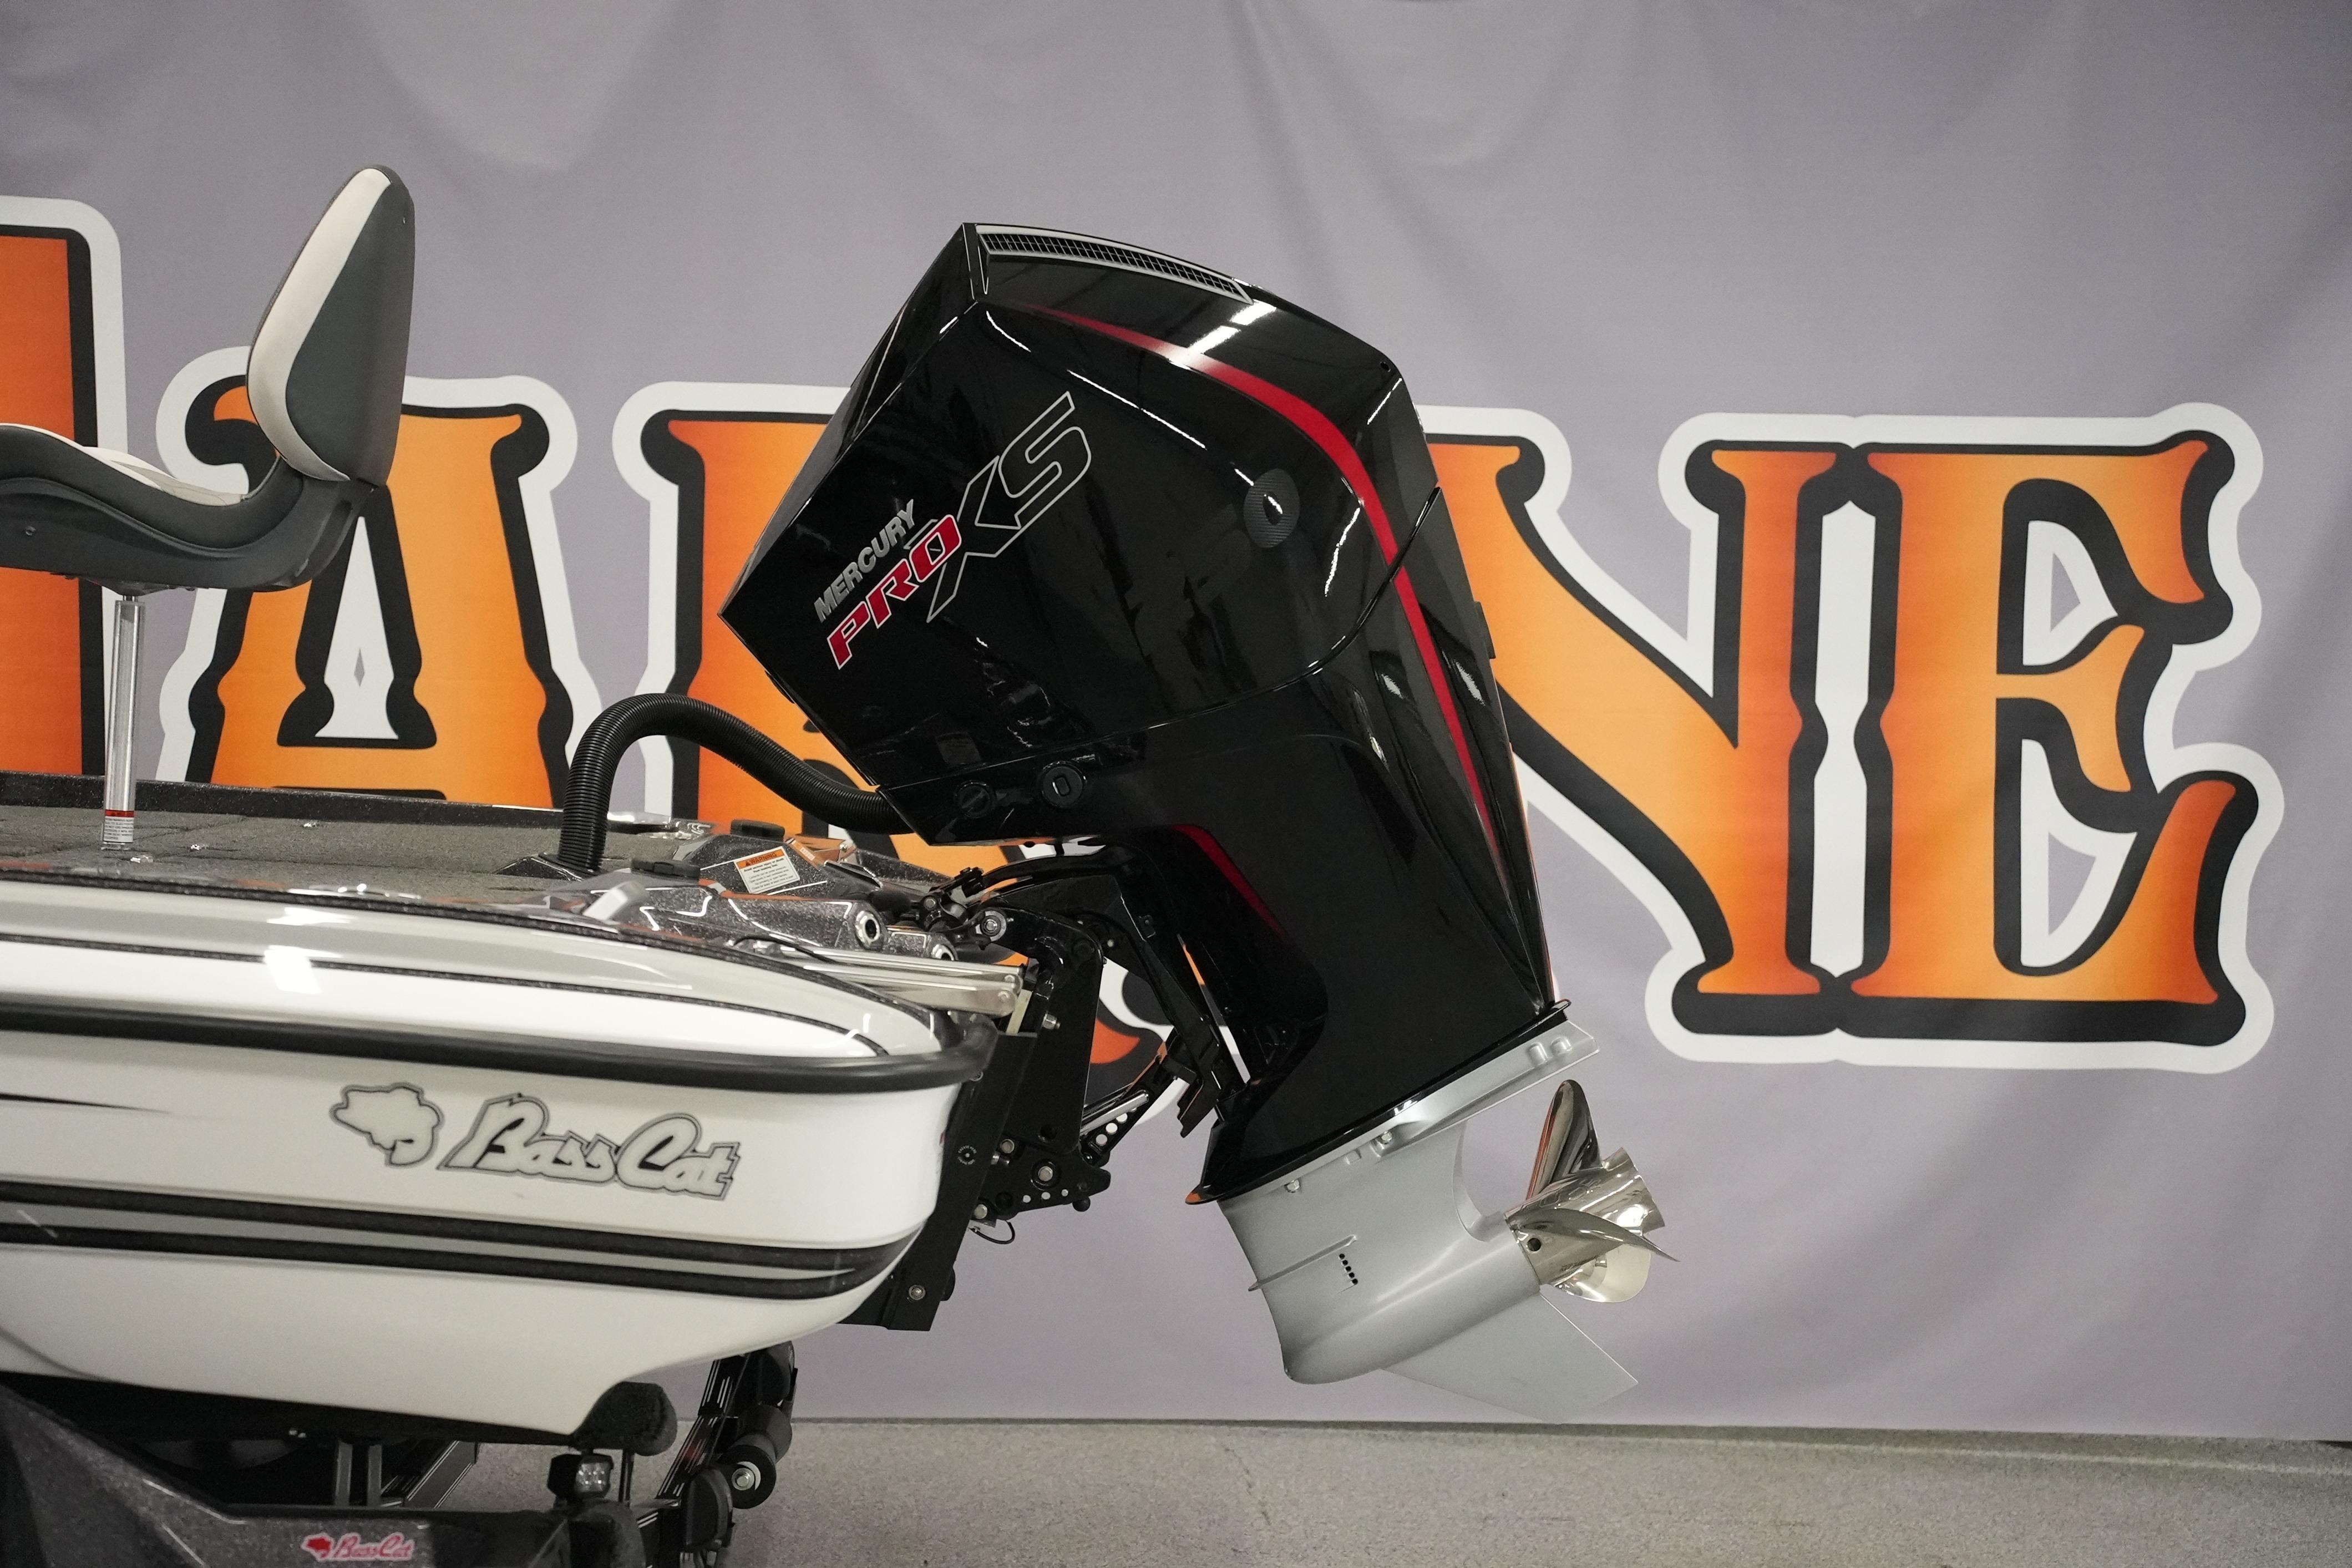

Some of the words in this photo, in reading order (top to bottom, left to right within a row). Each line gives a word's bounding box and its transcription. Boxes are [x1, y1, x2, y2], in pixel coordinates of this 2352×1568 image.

[814, 499, 915, 623] MERCURY
[827, 515, 962, 669] PRO
[749, 852, 777, 864] WARNING
